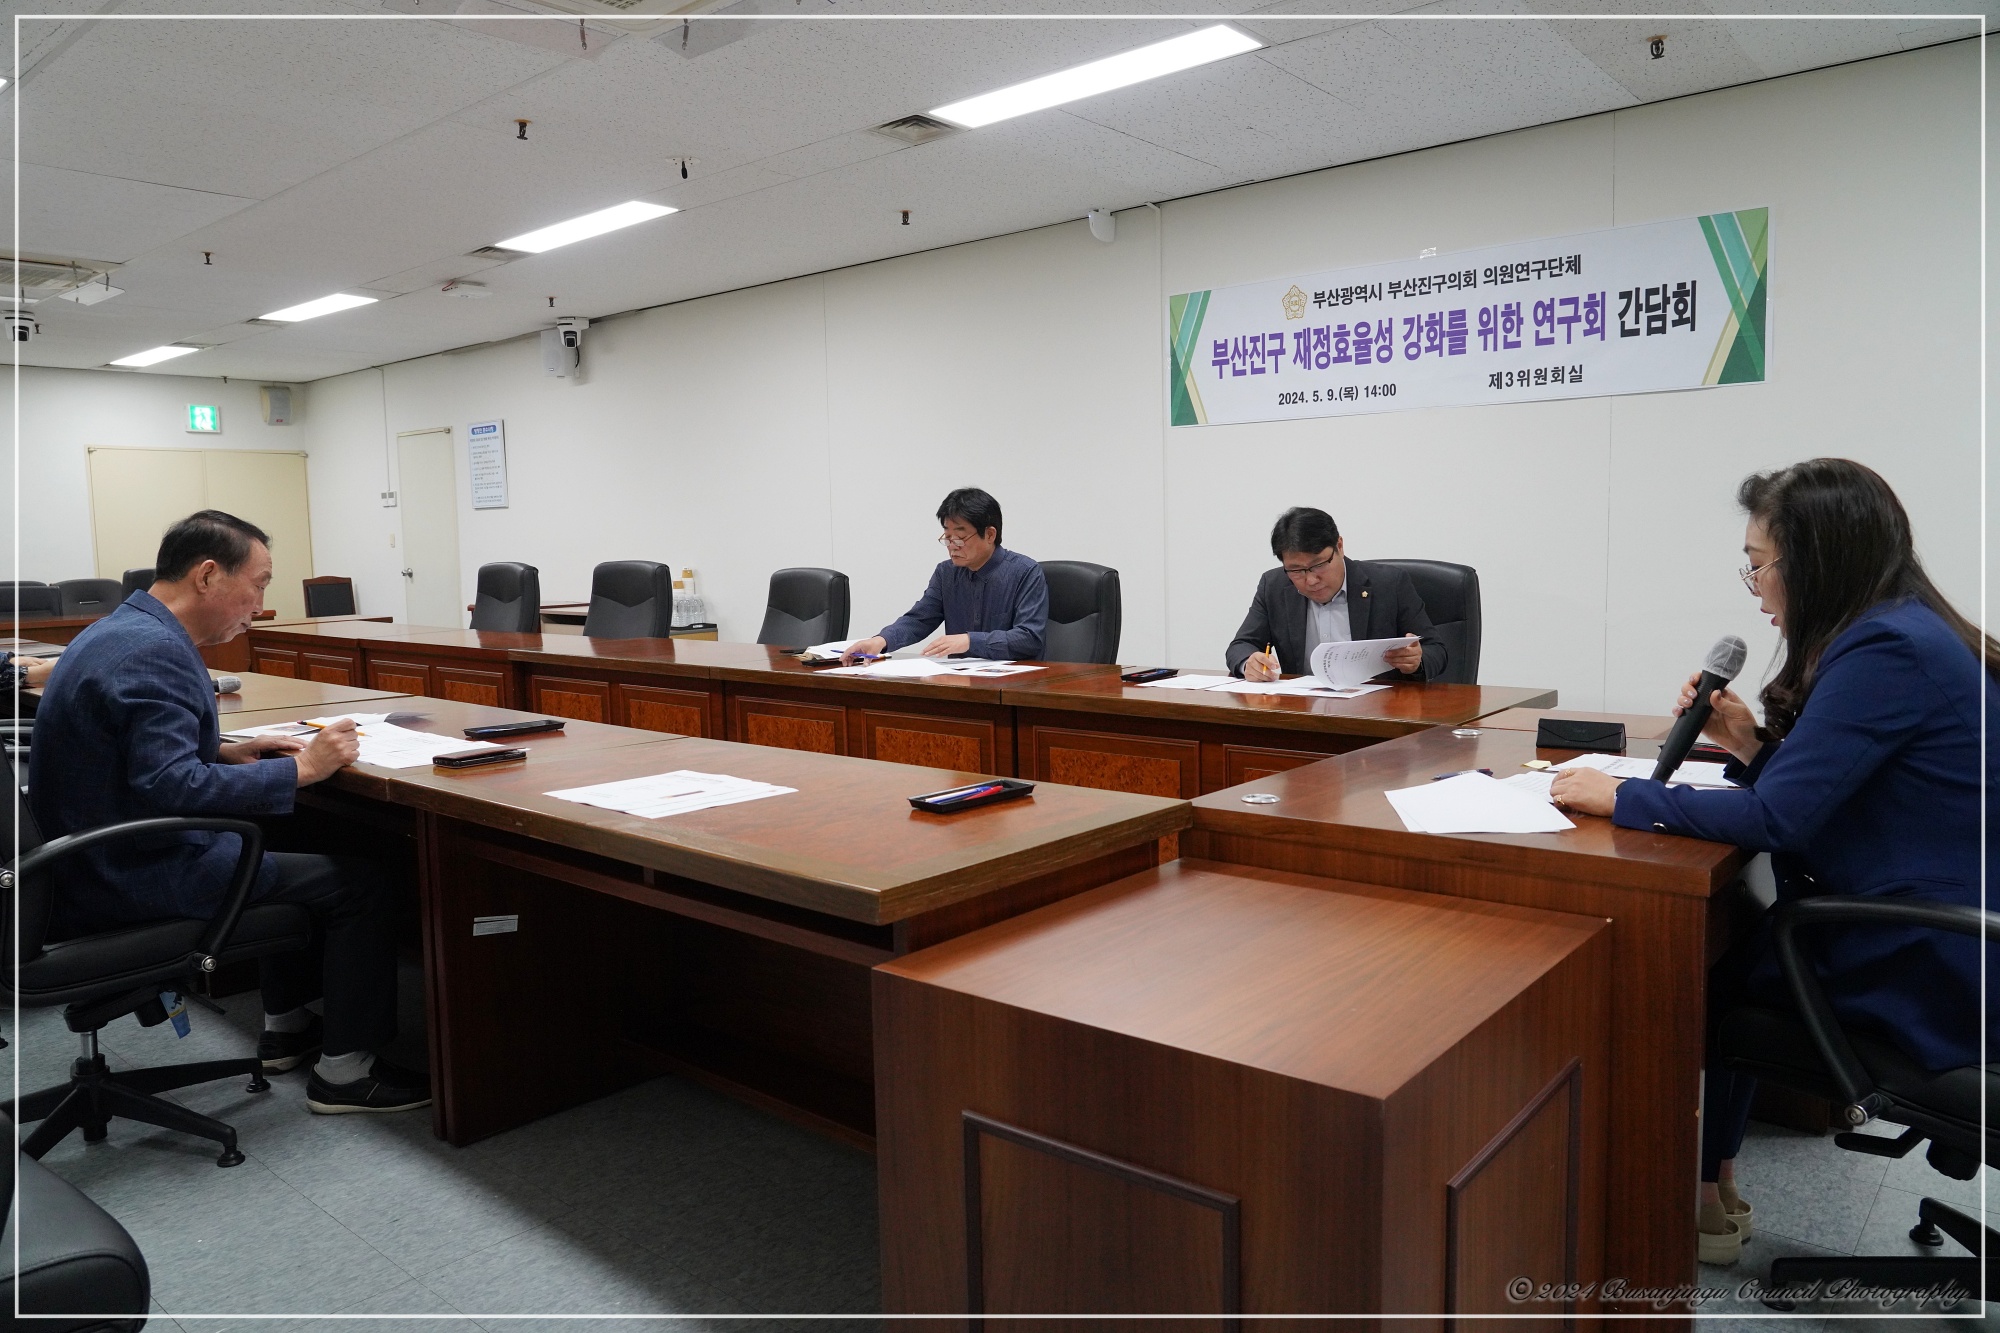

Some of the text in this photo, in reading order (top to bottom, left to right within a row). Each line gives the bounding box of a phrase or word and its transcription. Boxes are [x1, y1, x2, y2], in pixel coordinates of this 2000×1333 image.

[1312, 254, 1581, 309] 부산광역시 부산진구의회 의원연구단체
[1212, 280, 1697, 380] 부산진구 재정효율성 강화를 위한 연구회 간담회
[1278, 383, 1397, 406] 2024. 5. 9.(목) 14:00
[1489, 364, 1584, 390] 제3위원회실
